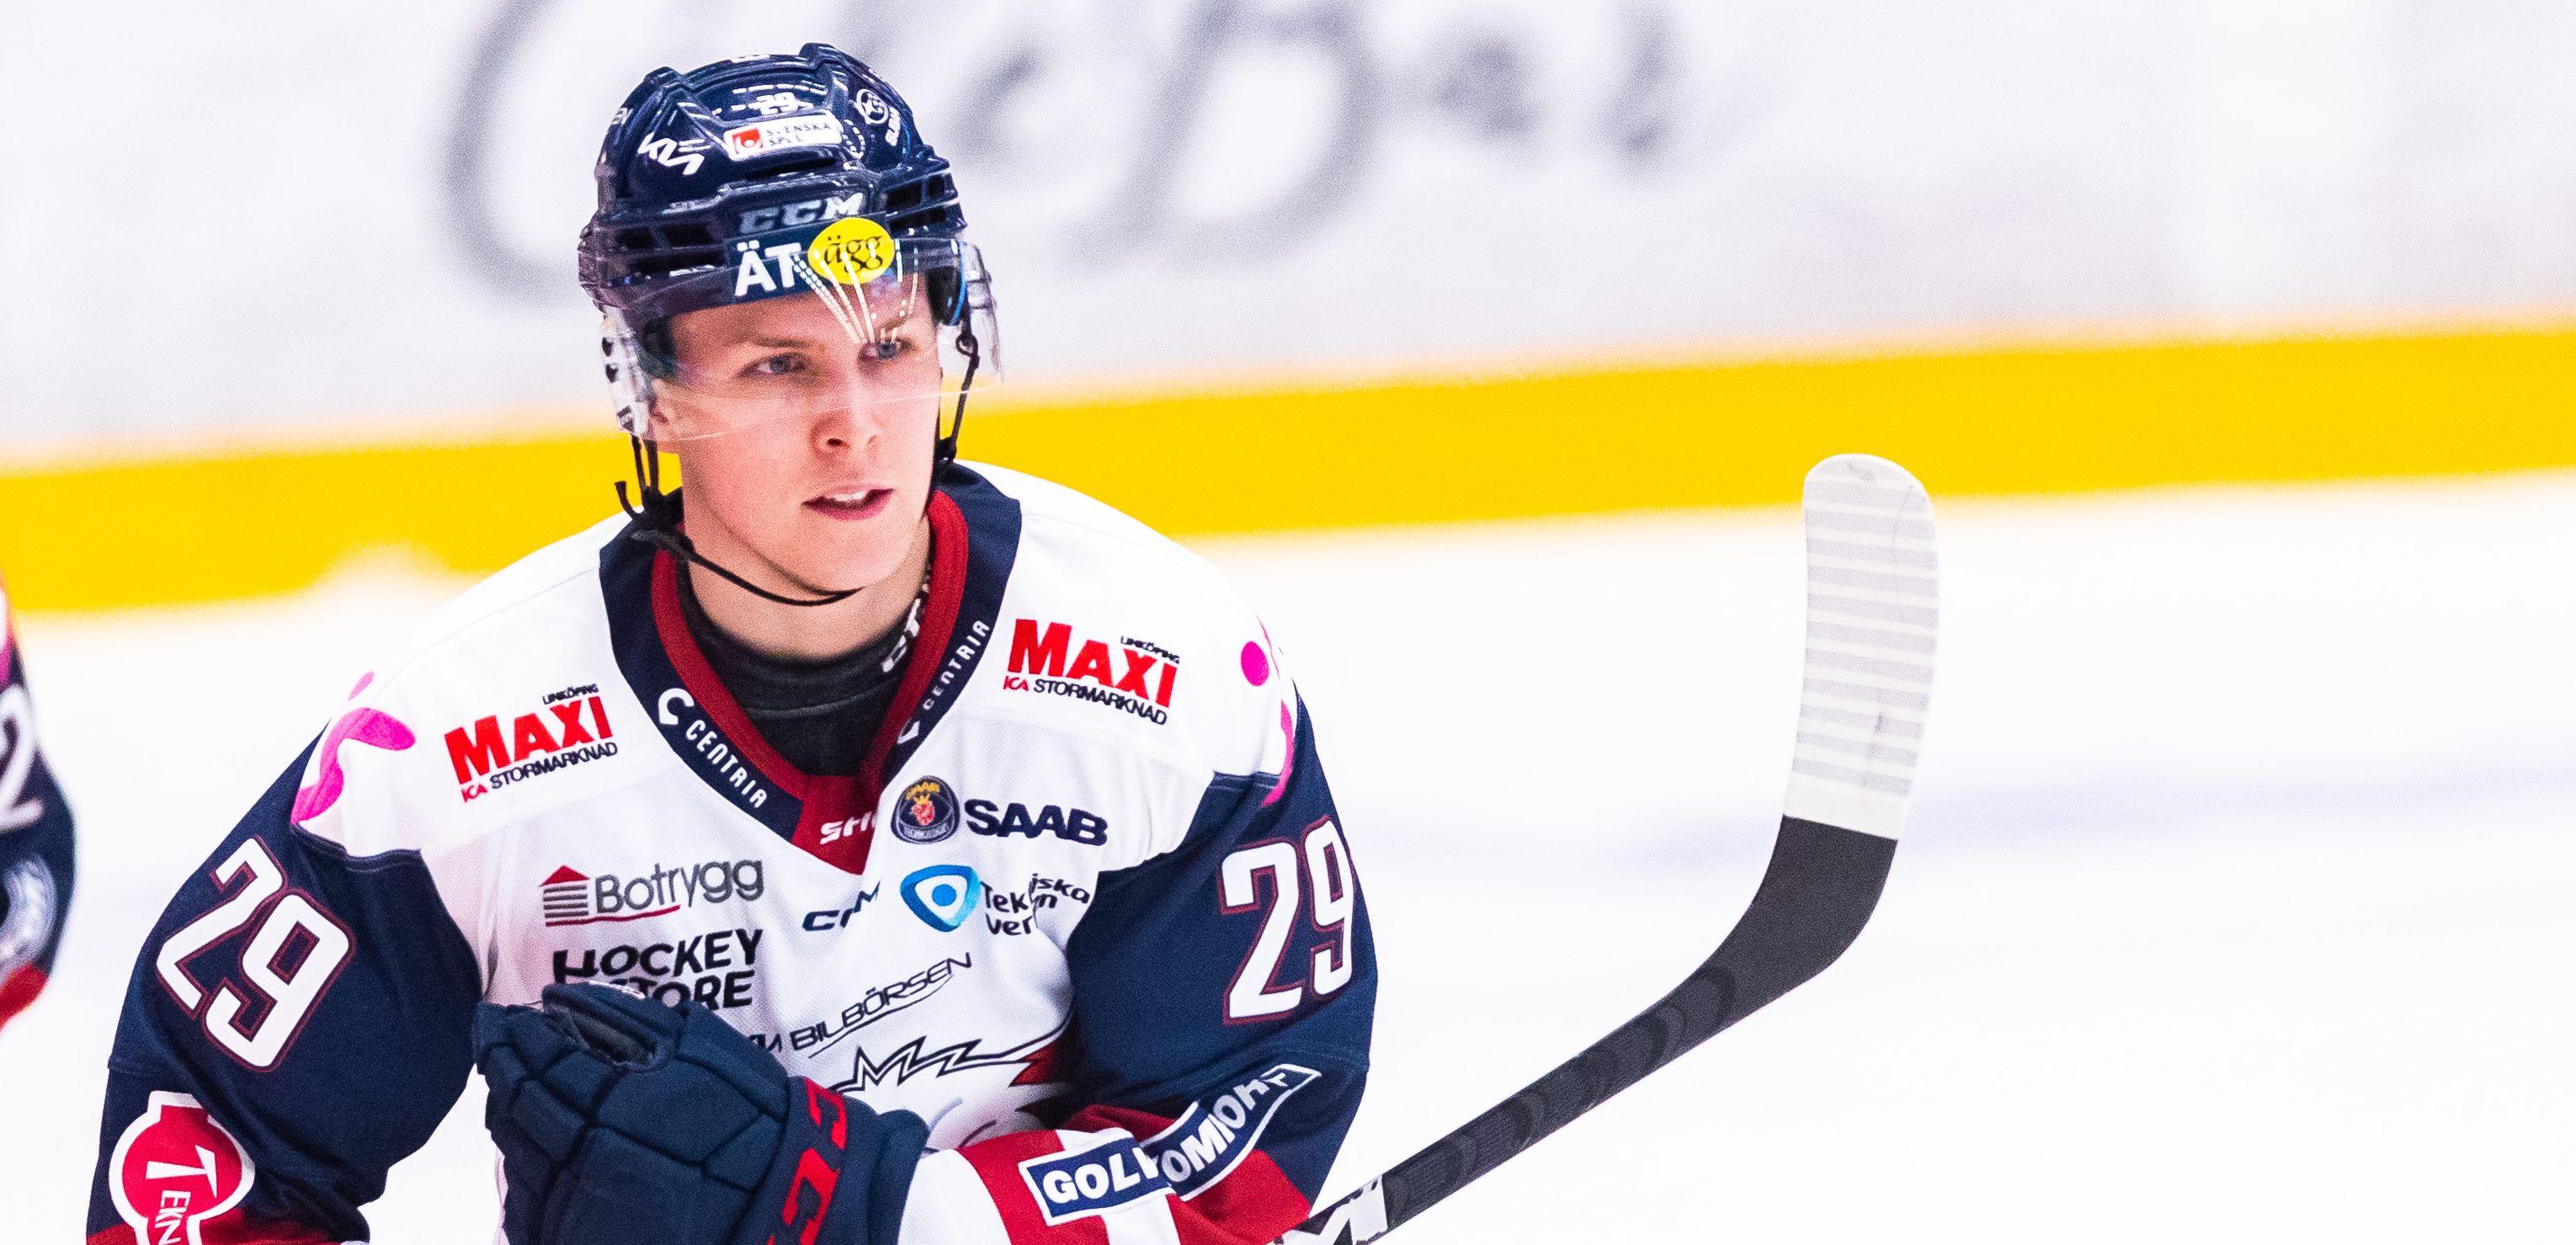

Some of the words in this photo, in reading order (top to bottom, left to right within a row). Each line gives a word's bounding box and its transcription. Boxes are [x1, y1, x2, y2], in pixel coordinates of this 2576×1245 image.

[739, 192, 864, 234] CCM
[734, 239, 802, 296] ÄT
[823, 234, 883, 274] ägg
[922, 620, 991, 710] CENTRIA
[1008, 618, 1178, 709] MAXI
[1120, 636, 1180, 665] LINKÖPING
[1003, 675, 1029, 692] ICA
[1033, 678, 1168, 726] STORMARKNAD
[444, 695, 614, 785] MAXI
[685, 719, 768, 808] CENTRIA
[460, 784, 488, 804] ICA
[489, 742, 619, 790] STORMARKNAD
[963, 798, 1109, 847] SAAB
[594, 859, 764, 914] Botrygg
[1221, 819, 1355, 1019] 29
[156, 836, 354, 1069] 29
[552, 928, 764, 985] HOCKEY
[608, 969, 756, 1011] TORE
[789, 951, 972, 1051] BILBÖRSEN
